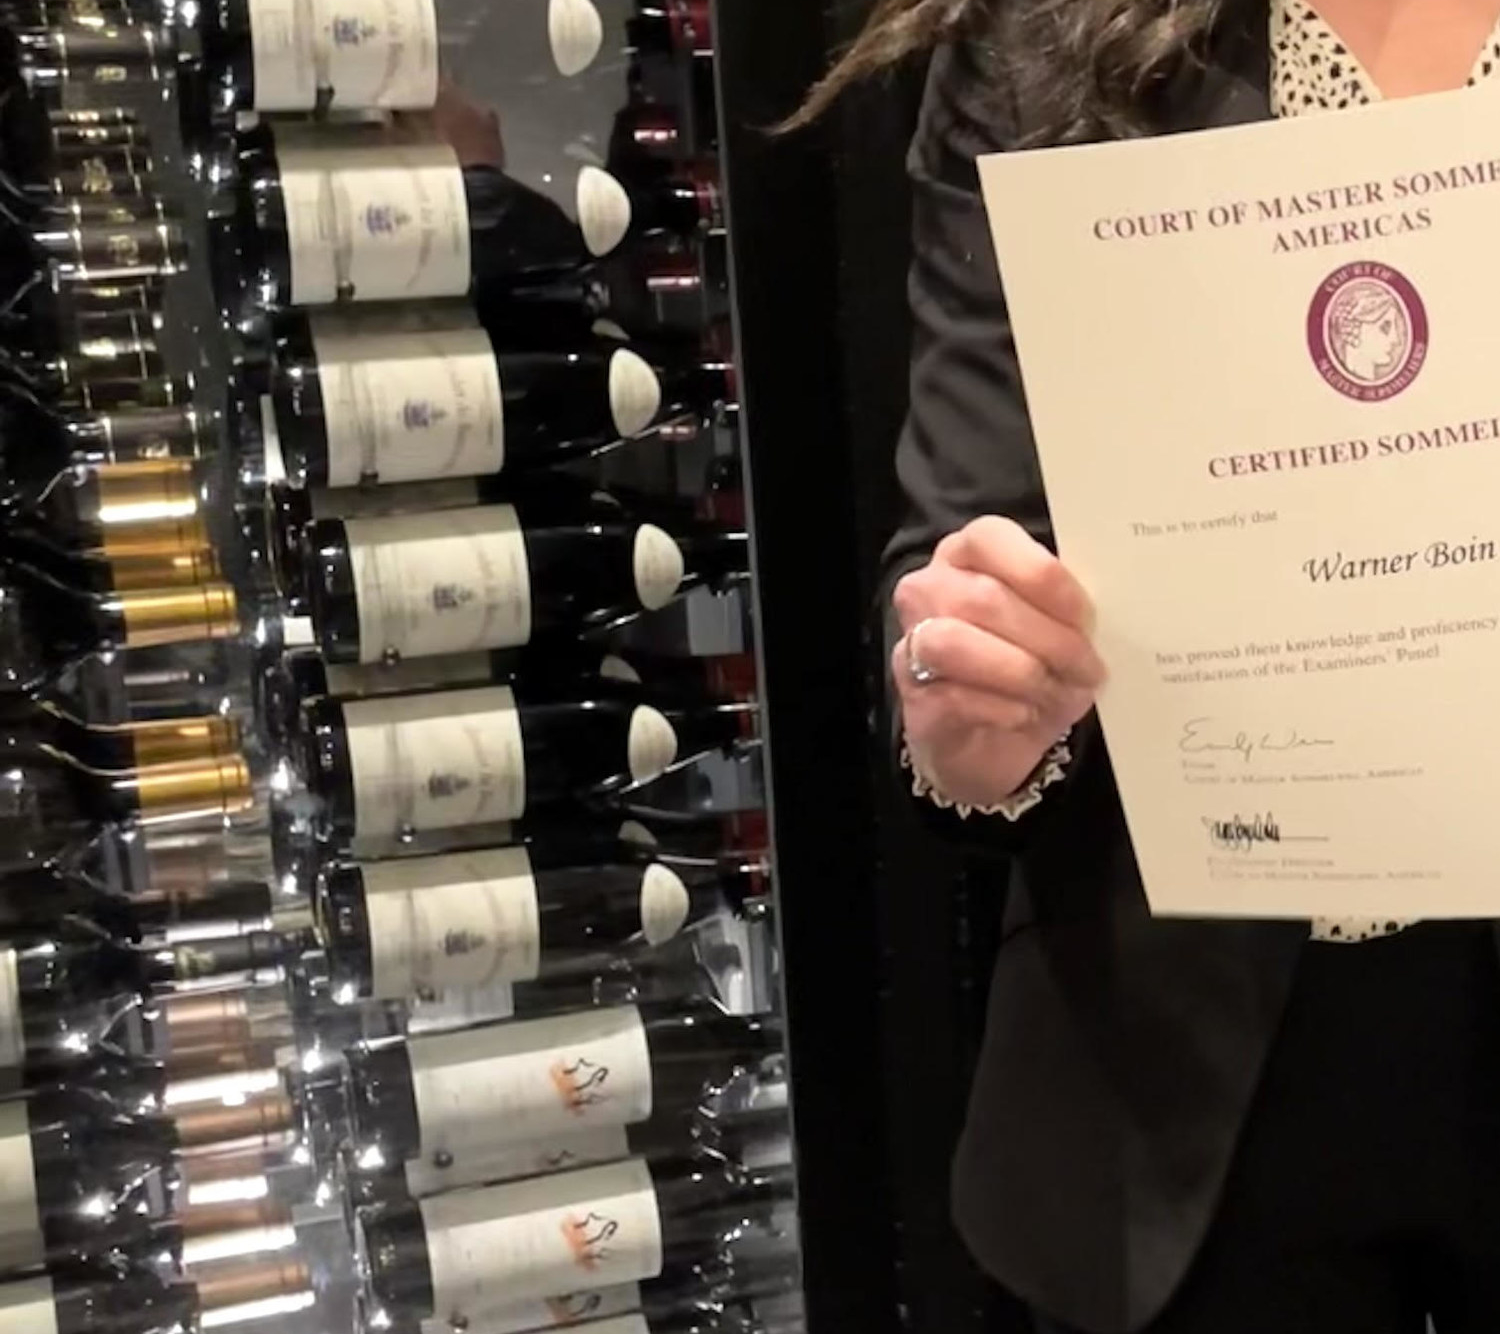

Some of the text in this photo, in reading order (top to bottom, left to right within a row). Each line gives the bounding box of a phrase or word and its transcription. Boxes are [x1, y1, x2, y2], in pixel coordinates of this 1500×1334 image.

[1092, 210, 1199, 241] COURT
[1208, 202, 1248, 229] OF
[1257, 181, 1385, 223] MASTER
[1271, 207, 1433, 255] AMERICAS
[1208, 438, 1369, 479] CERTIFIED
[1131, 521, 1163, 537] This
[1182, 519, 1198, 533] to
[1200, 511, 1246, 531] certify
[1251, 509, 1279, 525] that
[1301, 534, 1499, 584] Warner Boin
[1155, 651, 1183, 665] has
[1186, 644, 1241, 665] proved
[1245, 642, 1282, 658] their
[1285, 629, 1374, 653] knowledge
[1377, 625, 1406, 643] and
[1409, 615, 1500, 642] proficiency
[1161, 666, 1250, 685] satisfaction
[1252, 661, 1270, 678] of
[1274, 660, 1297, 677] the
[1395, 643, 1441, 664] Panel
